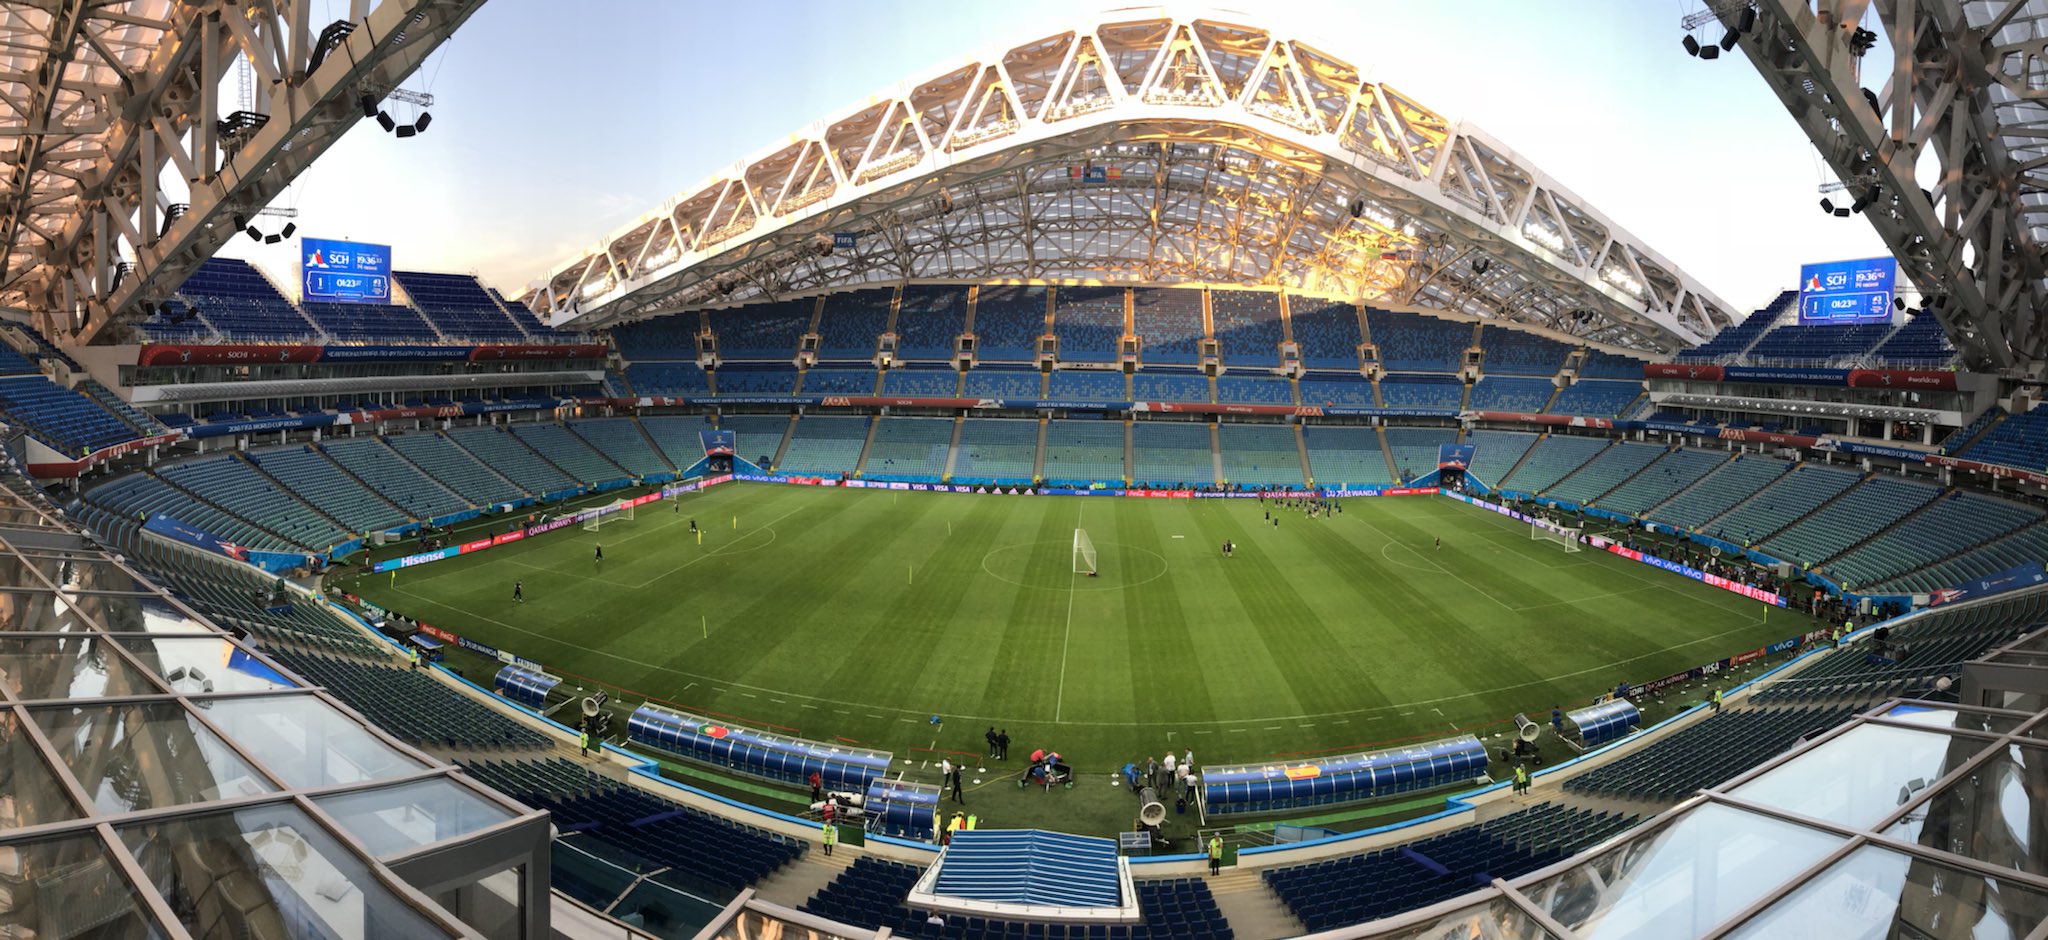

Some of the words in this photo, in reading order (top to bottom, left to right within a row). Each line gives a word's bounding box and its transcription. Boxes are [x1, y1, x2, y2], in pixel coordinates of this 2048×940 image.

[836, 236, 853, 244] FIFA
[329, 253, 350, 265] SCH
[356, 255, 376, 265] 19:36
[1826, 274, 1847, 287] SCH
[1855, 272, 1878, 282] 19:36
[1831, 299, 1851, 309] 01:23
[227, 351, 248, 359] SOCHI
[1908, 375, 1941, 385] #worldcup
[1852, 444, 1864, 452] 2018
[1876, 447, 1896, 456] WORLD
[1896, 449, 1908, 458] CUP
[932, 484, 949, 492] VISA
[954, 485, 971, 493] VISA
[1351, 489, 1378, 497] WANDA
[1264, 491, 1288, 499] QATAR
[528, 525, 548, 536] QATAR
[548, 517, 573, 530] AIRWAYS
[400, 551, 445, 568] Hisense
[1644, 555, 1661, 567] vivo
[1663, 561, 1681, 573] vivo
[1683, 567, 1702, 580] vivo
[1773, 639, 1794, 652] vivo
[1702, 661, 1719, 675] VISA
